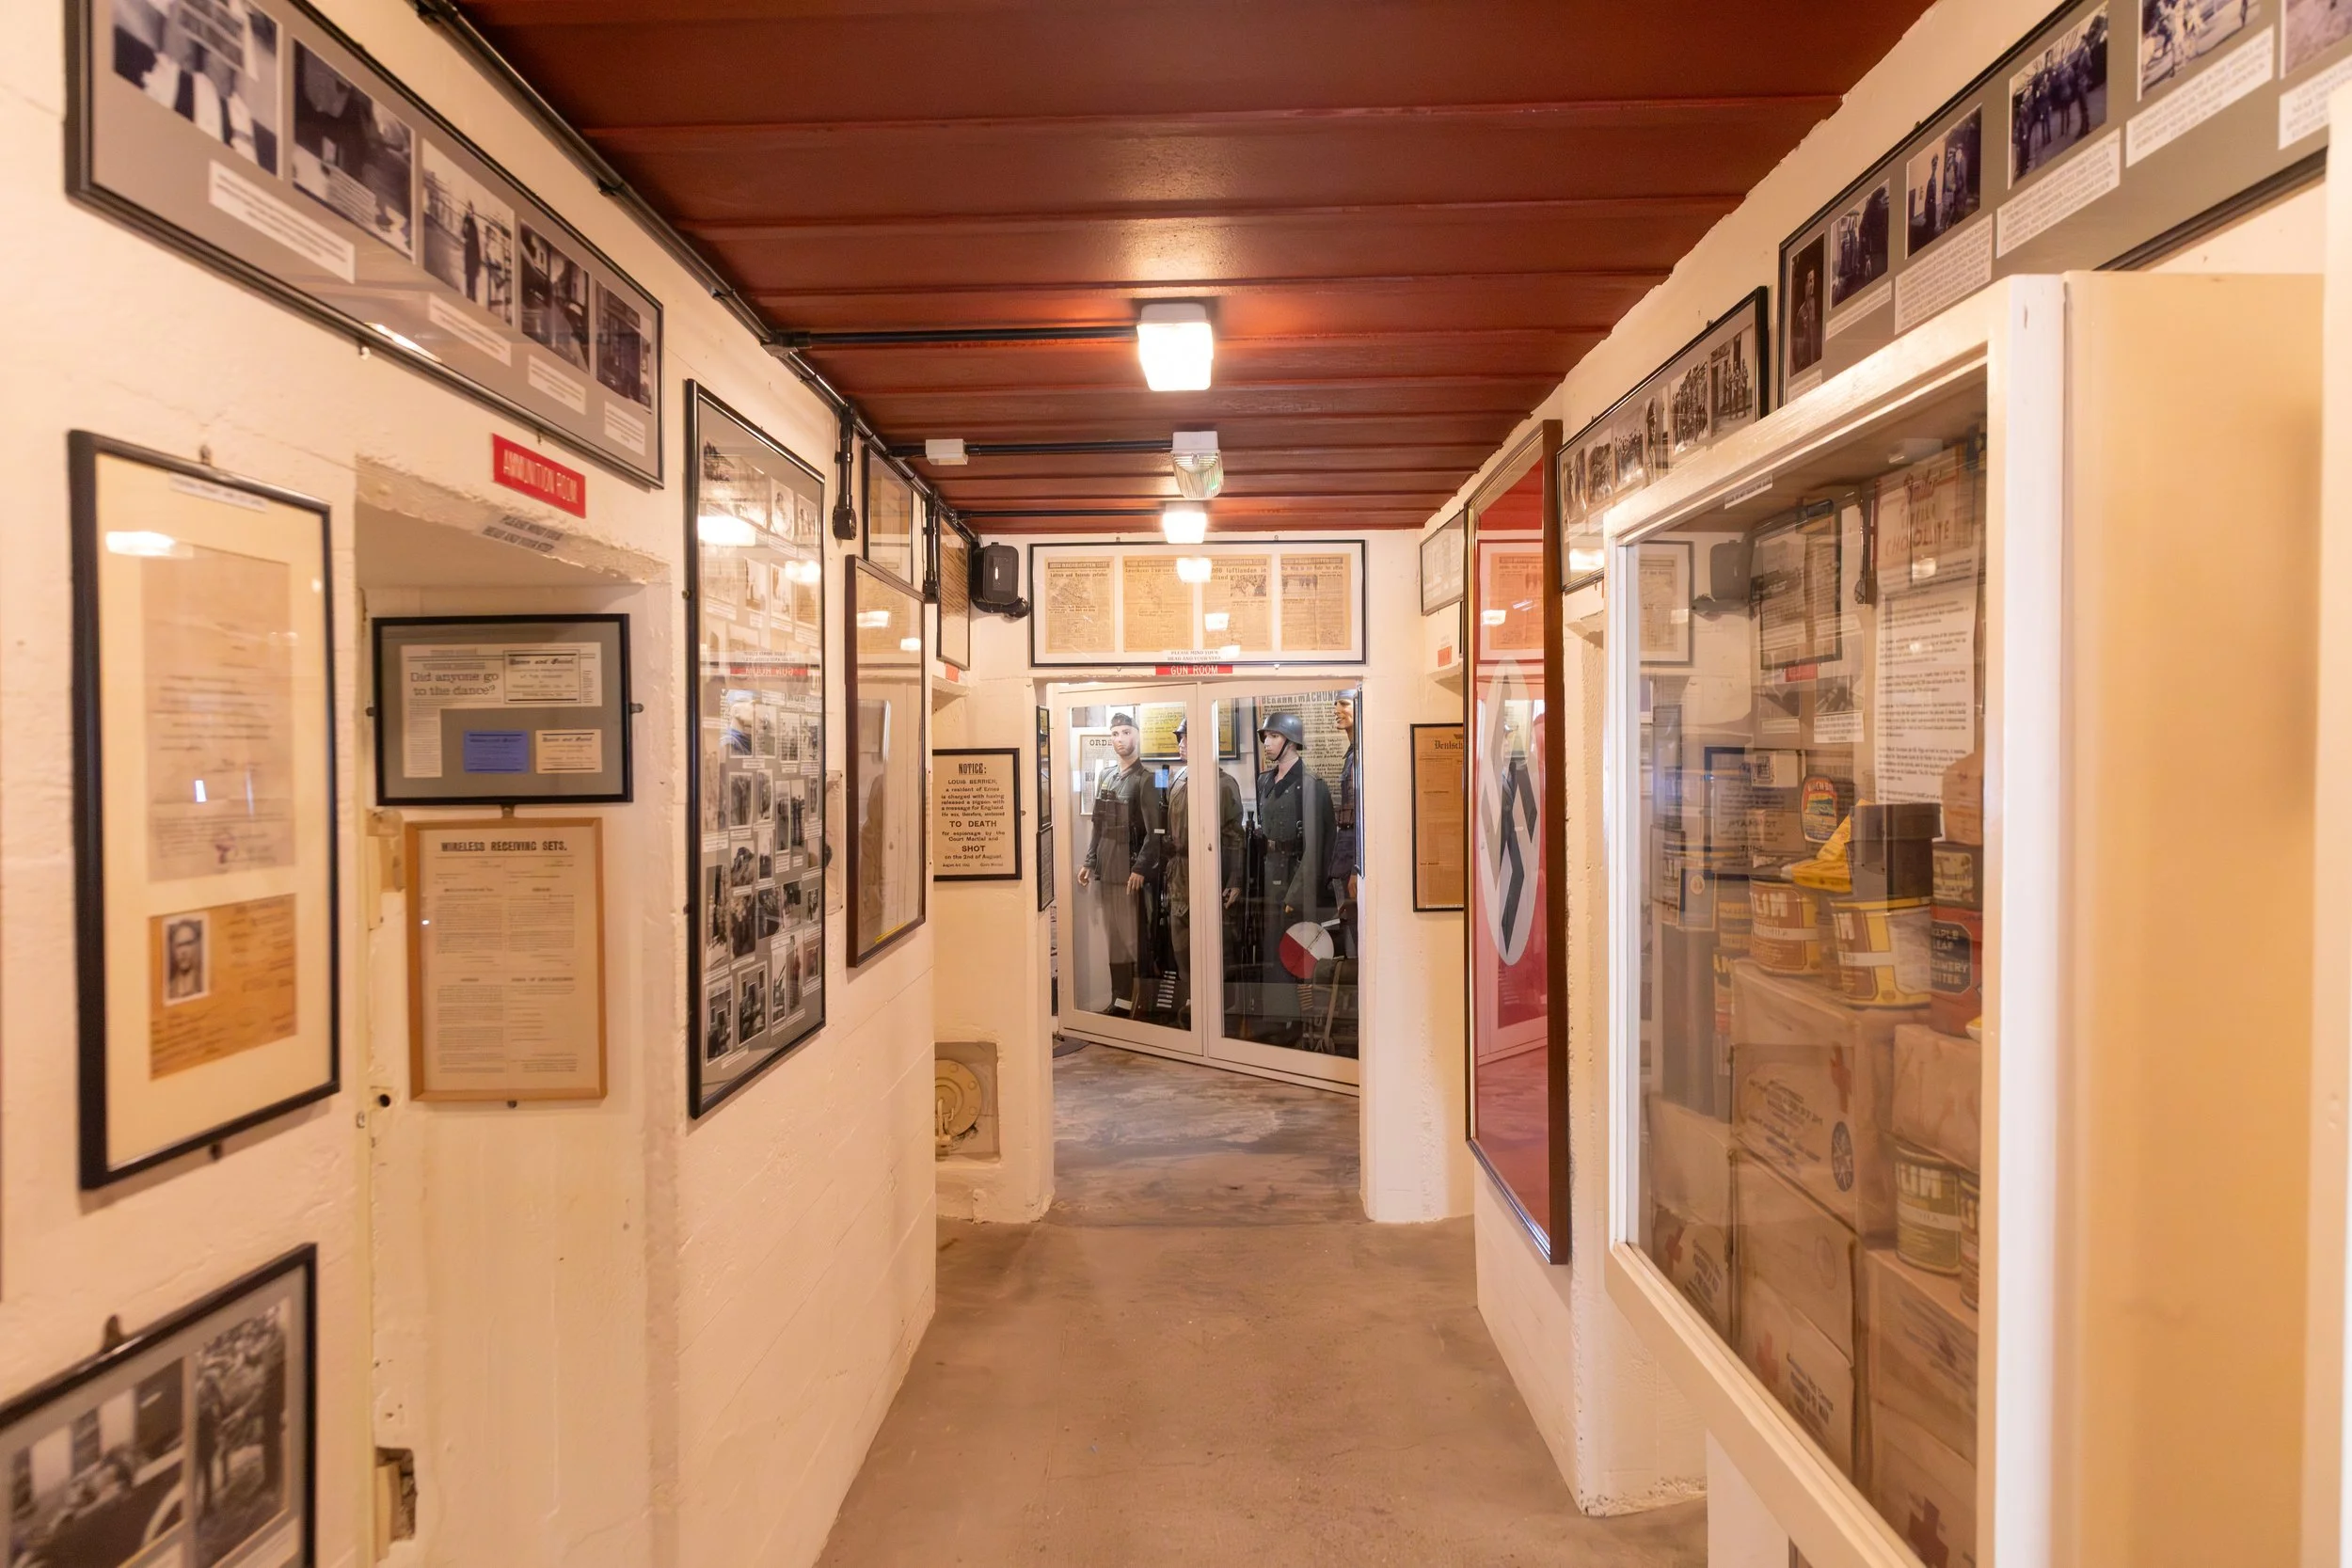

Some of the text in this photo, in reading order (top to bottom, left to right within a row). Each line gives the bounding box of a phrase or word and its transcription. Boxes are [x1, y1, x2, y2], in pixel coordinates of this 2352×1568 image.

[557, 472, 578, 504] ROOM
[1170, 665, 1218, 675] GUN ROOM
[410, 672, 431, 683] Did
[436, 673, 480, 683] anyone
[484, 673, 500, 683] go
[414, 685, 496, 696] to the dance?
[959, 763, 987, 774] NOTICE:
[441, 841, 567, 852] WIRELESS RECEIVING SETS.
